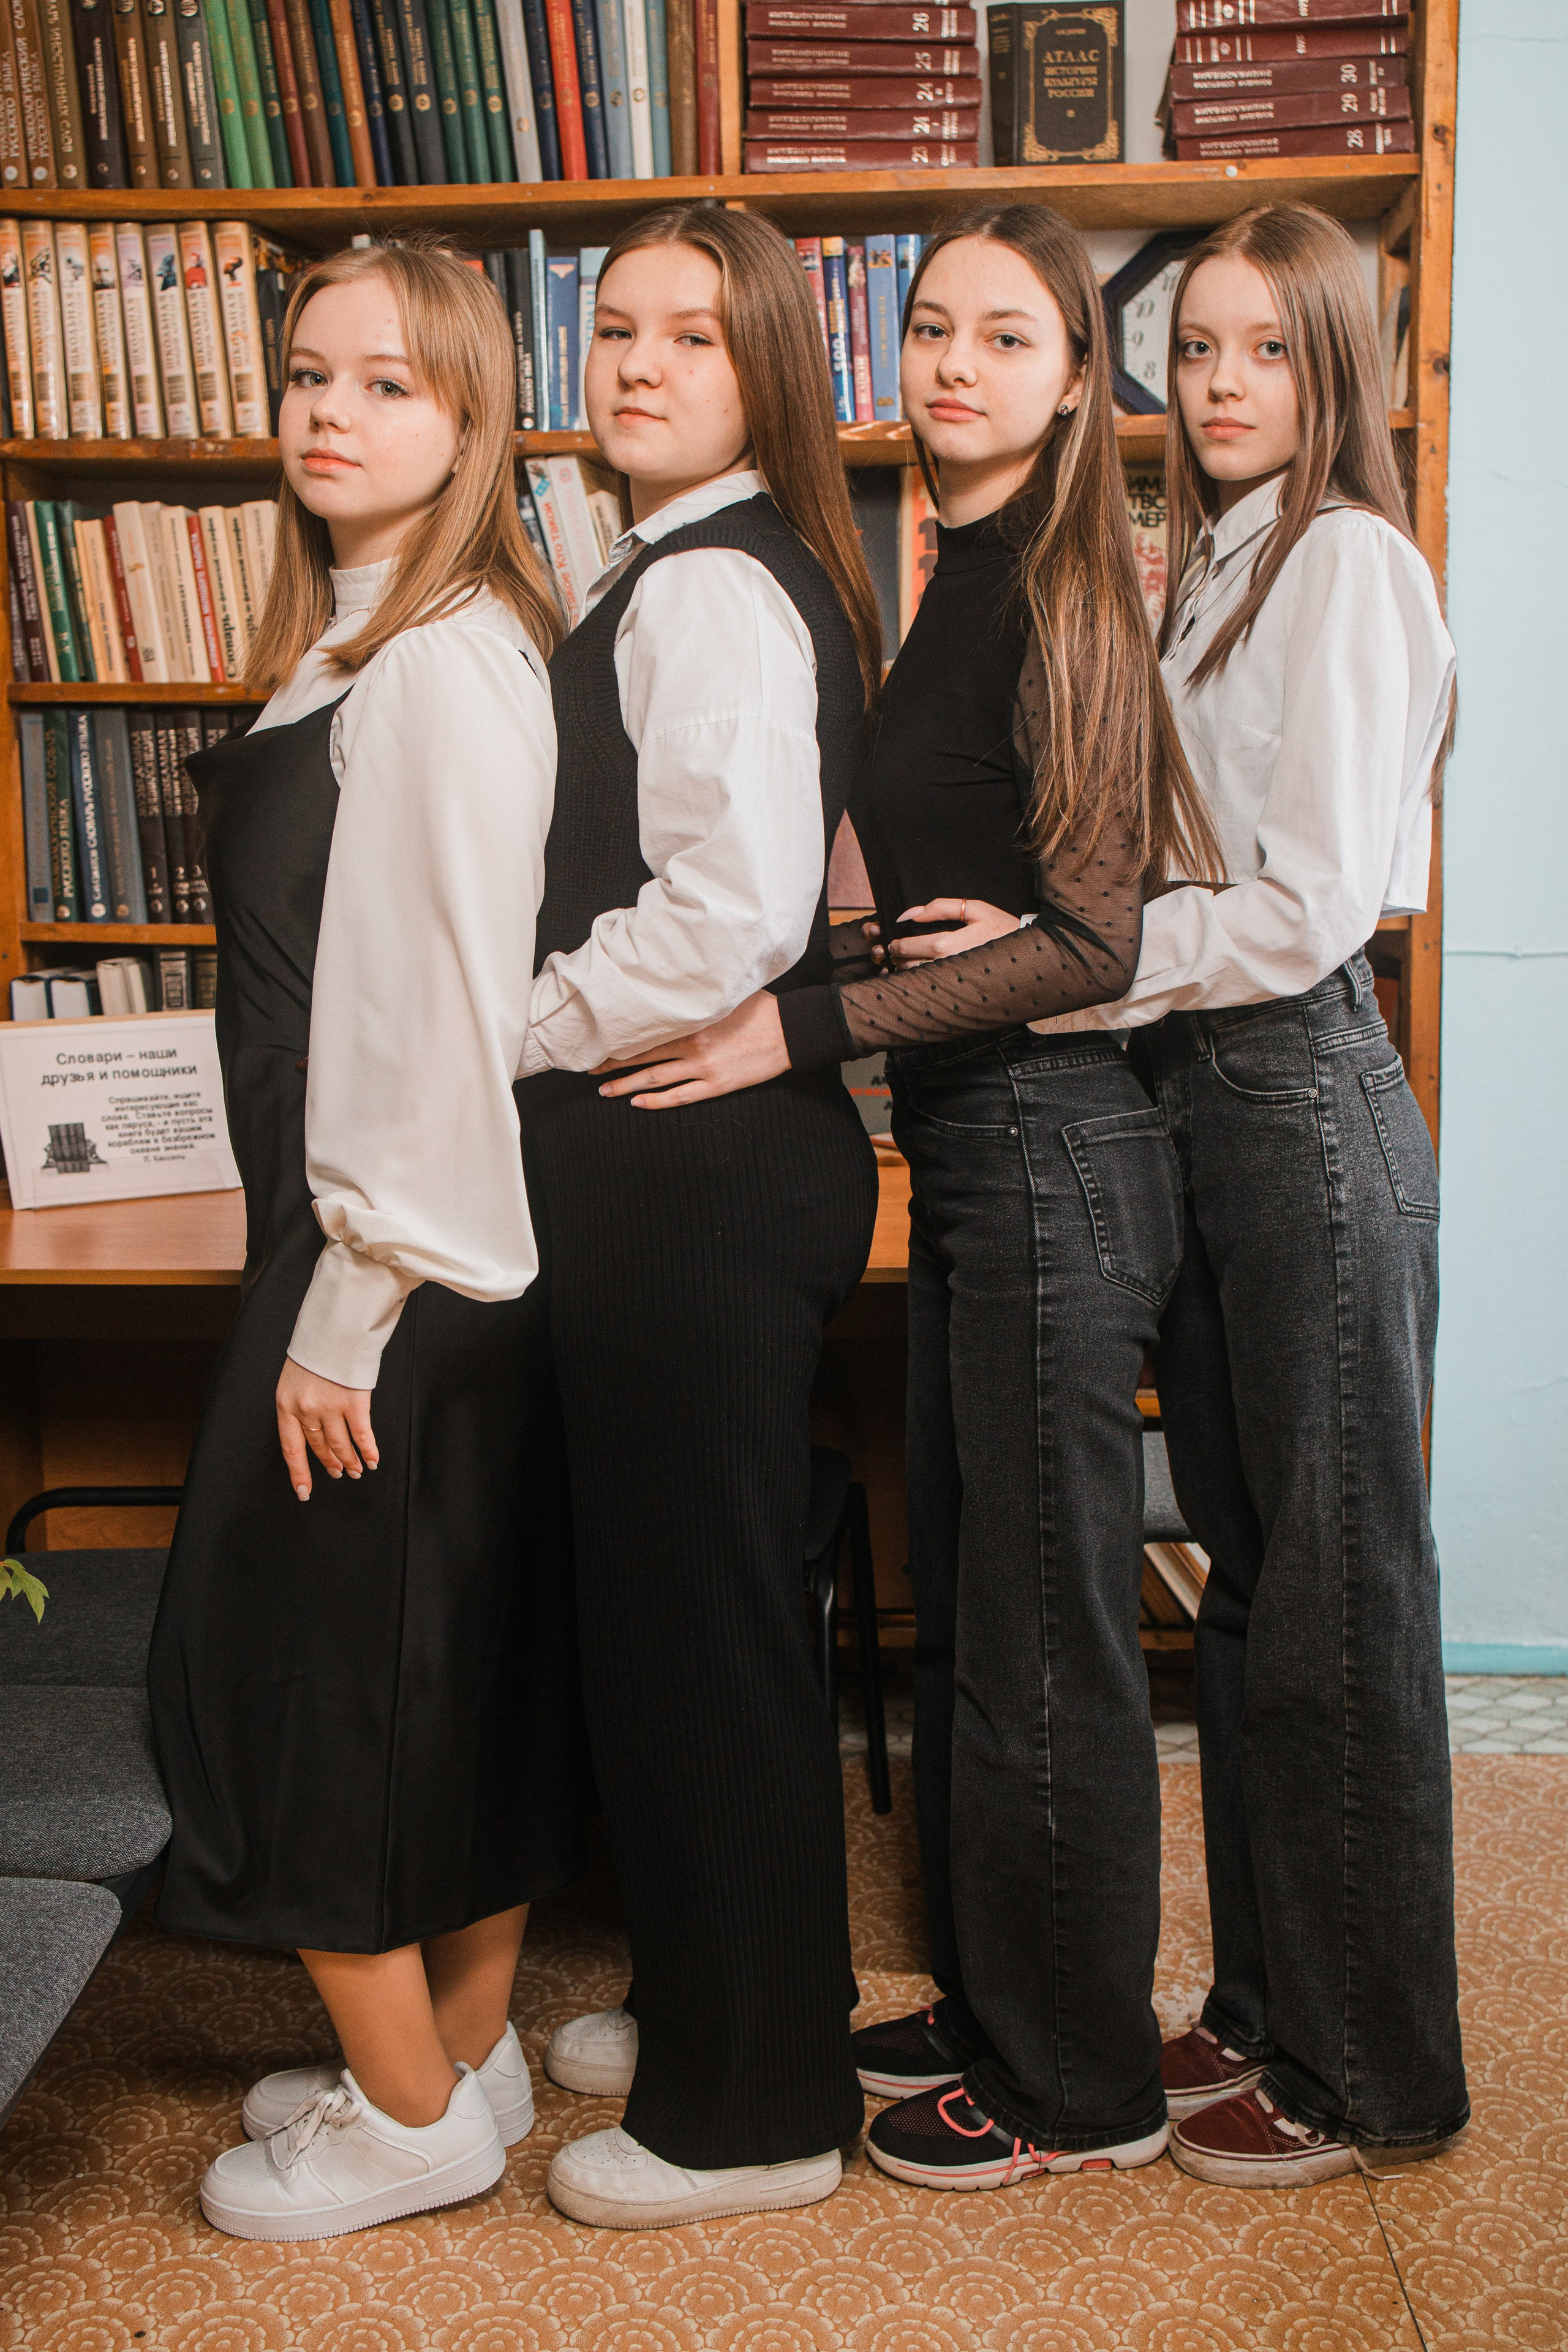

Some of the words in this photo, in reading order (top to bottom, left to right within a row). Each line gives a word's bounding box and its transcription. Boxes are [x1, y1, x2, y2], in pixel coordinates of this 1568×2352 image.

[912, 12, 930, 32] 26
[914, 52, 932, 70] 25
[1340, 64, 1357, 83] 30
[916, 82, 933, 102] 24
[1341, 93, 1358, 112] 29
[912, 116, 930, 134] 24
[1346, 129, 1363, 148] 28
[911, 146, 929, 164] 23
[1136, 298, 1155, 318] 10
[1132, 330, 1144, 353] 9
[1144, 360, 1157, 379] 8
[56, 1052, 123, 1065] Словари
[139, 1049, 177, 1060] наши
[41, 1072, 94, 1087] друзья
[99, 1070, 108, 1079] и
[113, 1065, 197, 1079] помощники
